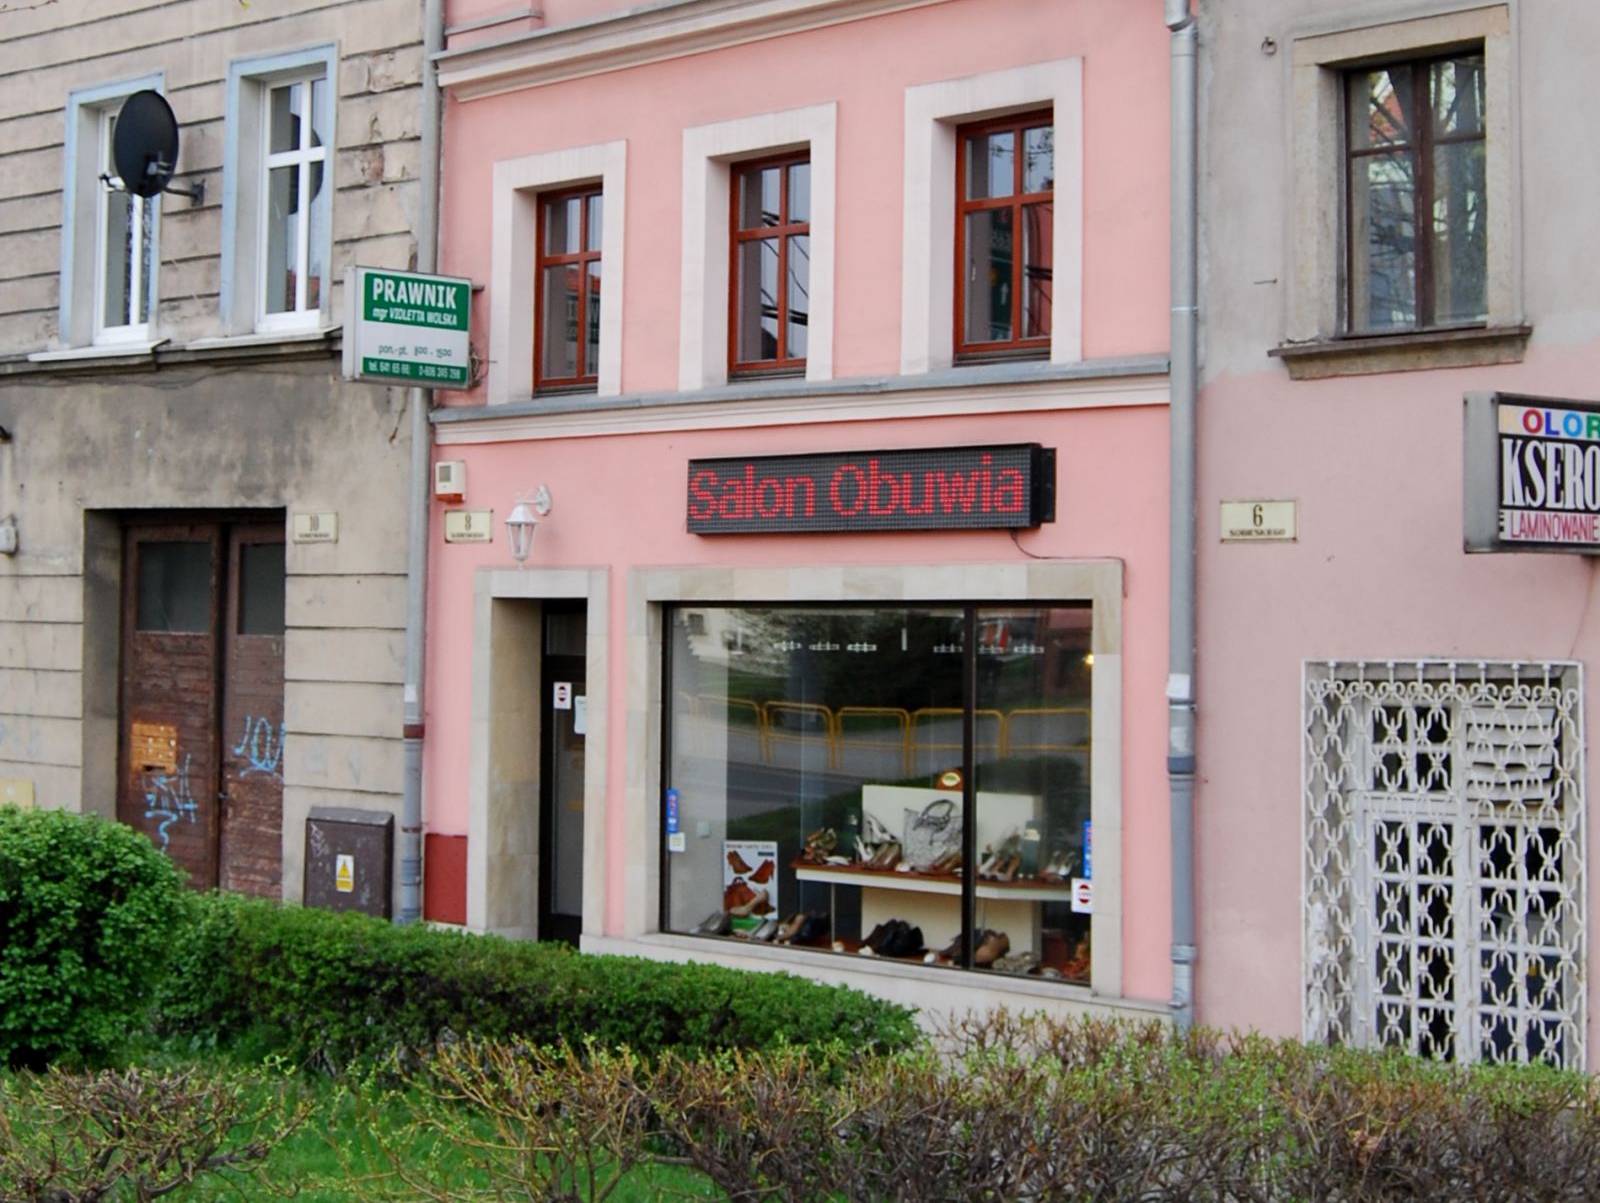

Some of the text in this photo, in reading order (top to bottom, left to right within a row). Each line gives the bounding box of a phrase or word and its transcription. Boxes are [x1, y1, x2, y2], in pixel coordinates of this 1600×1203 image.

[373, 277, 458, 310] PRAWNIK
[389, 307, 426, 323] VIOLETTA
[426, 311, 458, 326] WOLSKA
[689, 453, 1026, 521] Salon Obuwia
[1502, 438, 1600, 511] KSERO
[309, 515, 320, 532] 10
[464, 513, 473, 531] 8
[1252, 503, 1264, 527] 6
[1511, 510, 1600, 542] LAMINOWANIE
